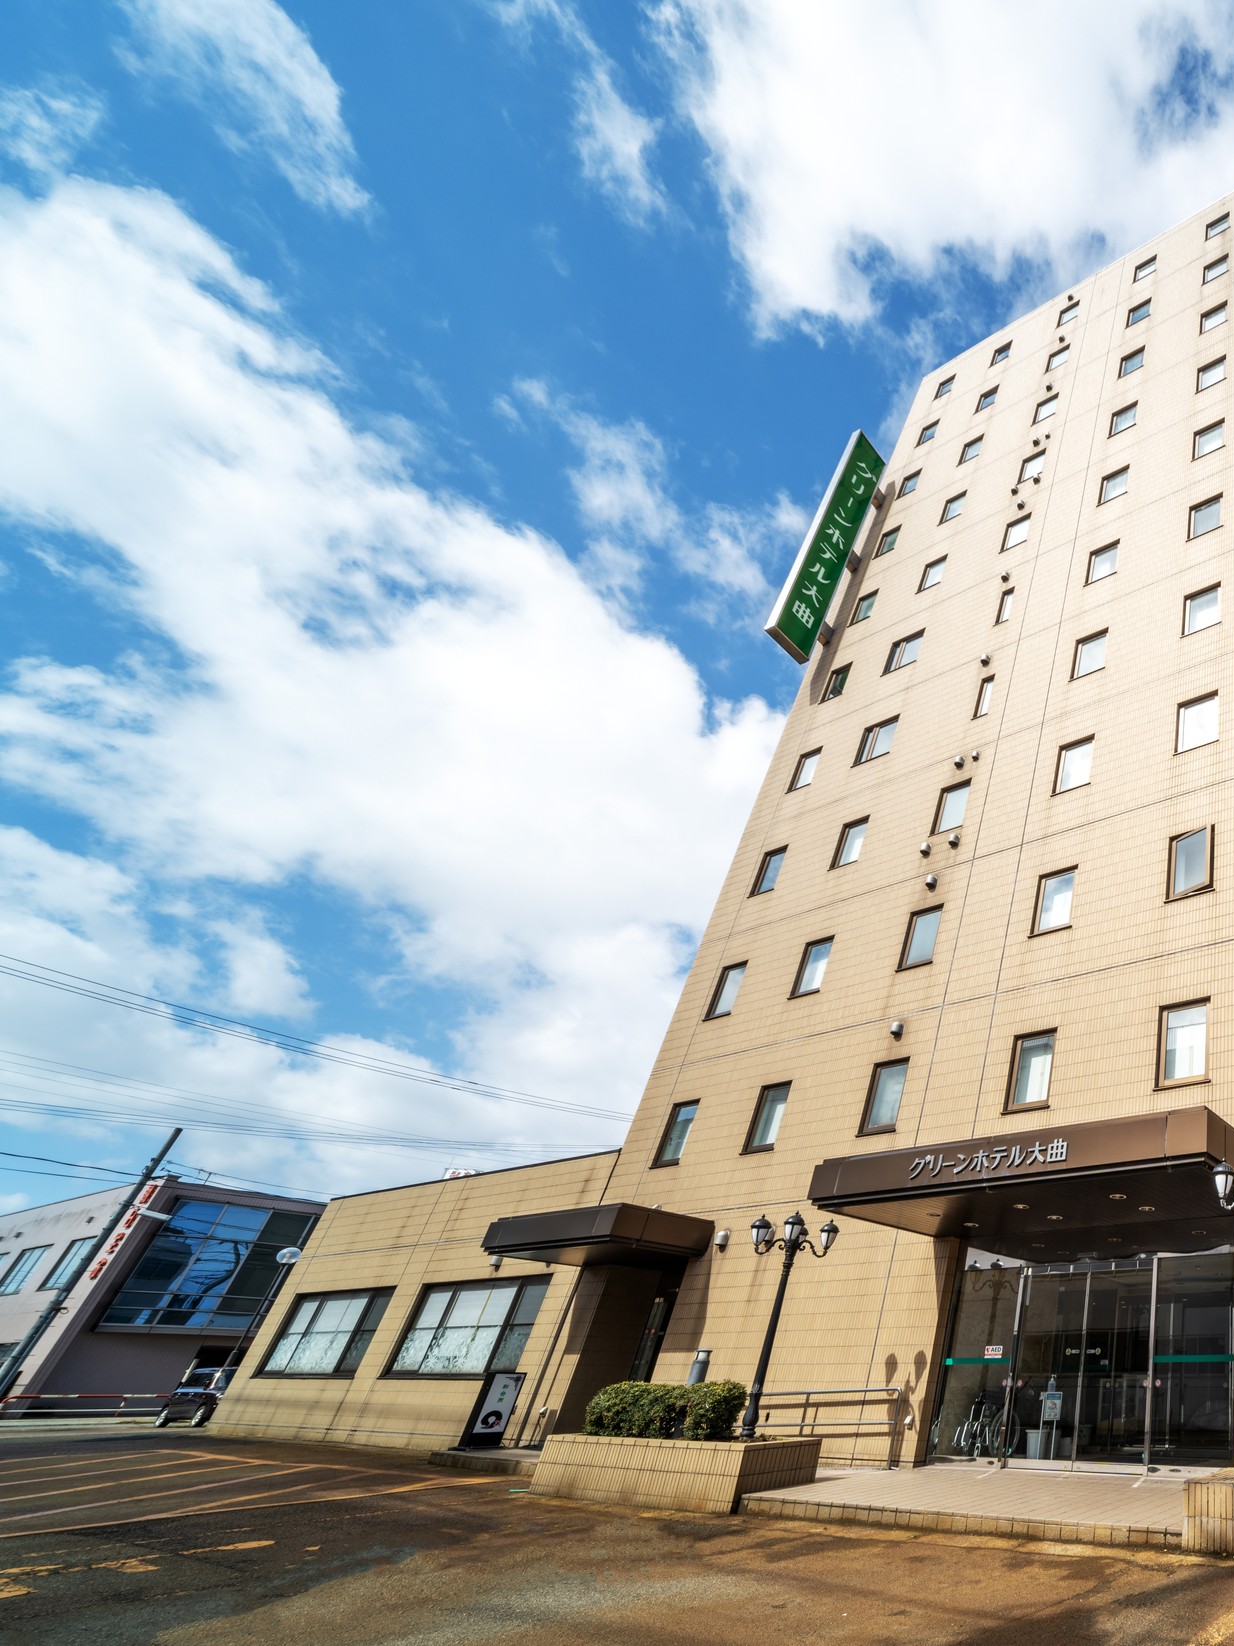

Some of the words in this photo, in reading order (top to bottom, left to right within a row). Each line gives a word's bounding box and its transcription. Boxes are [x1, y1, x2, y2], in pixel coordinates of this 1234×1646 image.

[792, 461, 876, 629] グリーンホテル大曲
[908, 1138, 1069, 1180] グリーンホテル大曲
